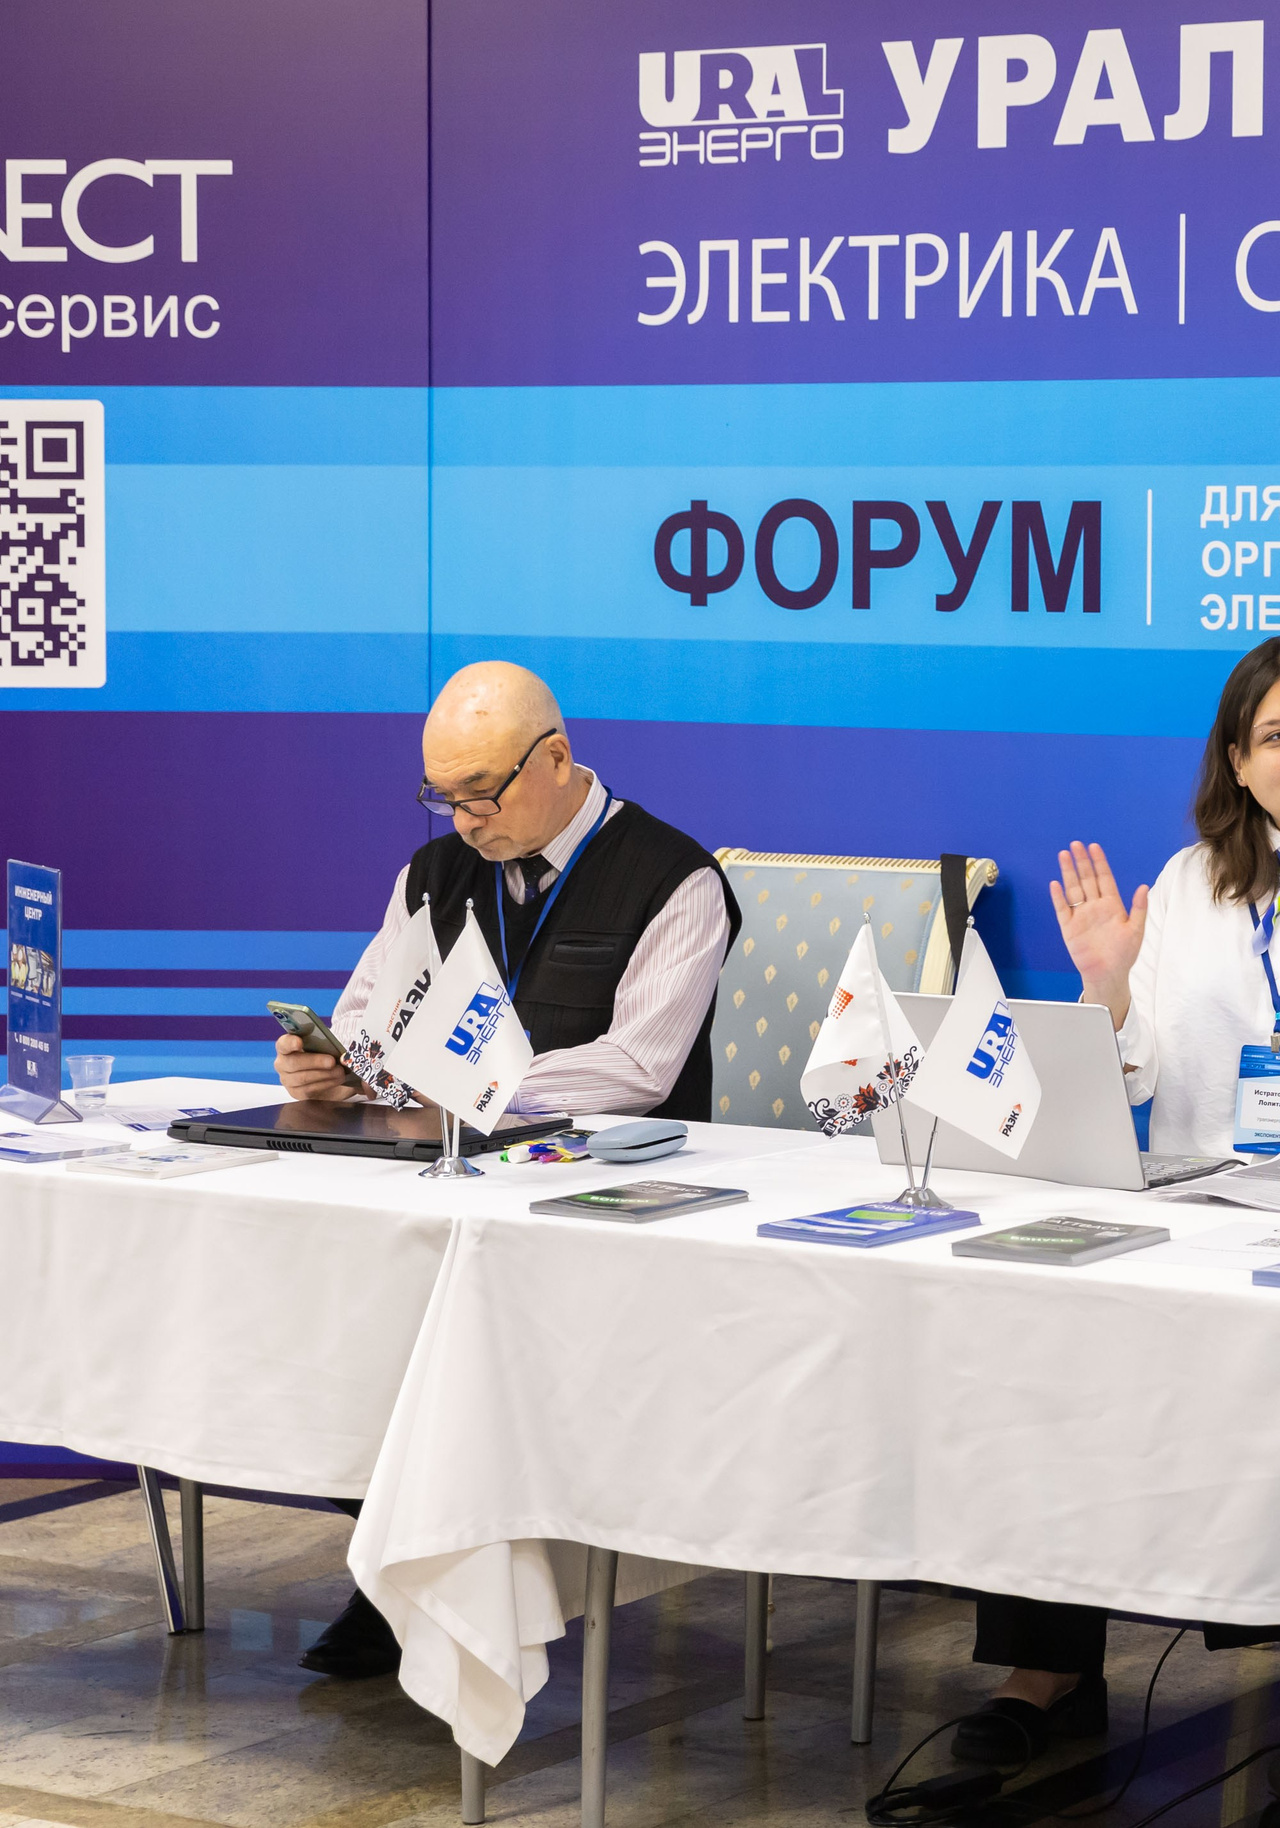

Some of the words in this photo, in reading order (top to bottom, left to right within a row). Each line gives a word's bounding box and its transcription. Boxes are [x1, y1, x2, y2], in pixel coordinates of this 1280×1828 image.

[638, 43, 844, 127] URAL
[638, 124, 844, 167] ЭНЕРГО
[0, 158, 233, 263] ECT
[638, 228, 1139, 326] ЭЛЕКТРИКА
[654, 499, 1102, 613] ФОРУМ
[445, 981, 504, 1059] URAL
[466, 990, 511, 1065] ЭНЕРГО
[988, 1019, 1019, 1089] ЭНЕРГ
[476, 1087, 496, 1113] РАЭК
[1002, 1110, 1020, 1137] РАЭК
